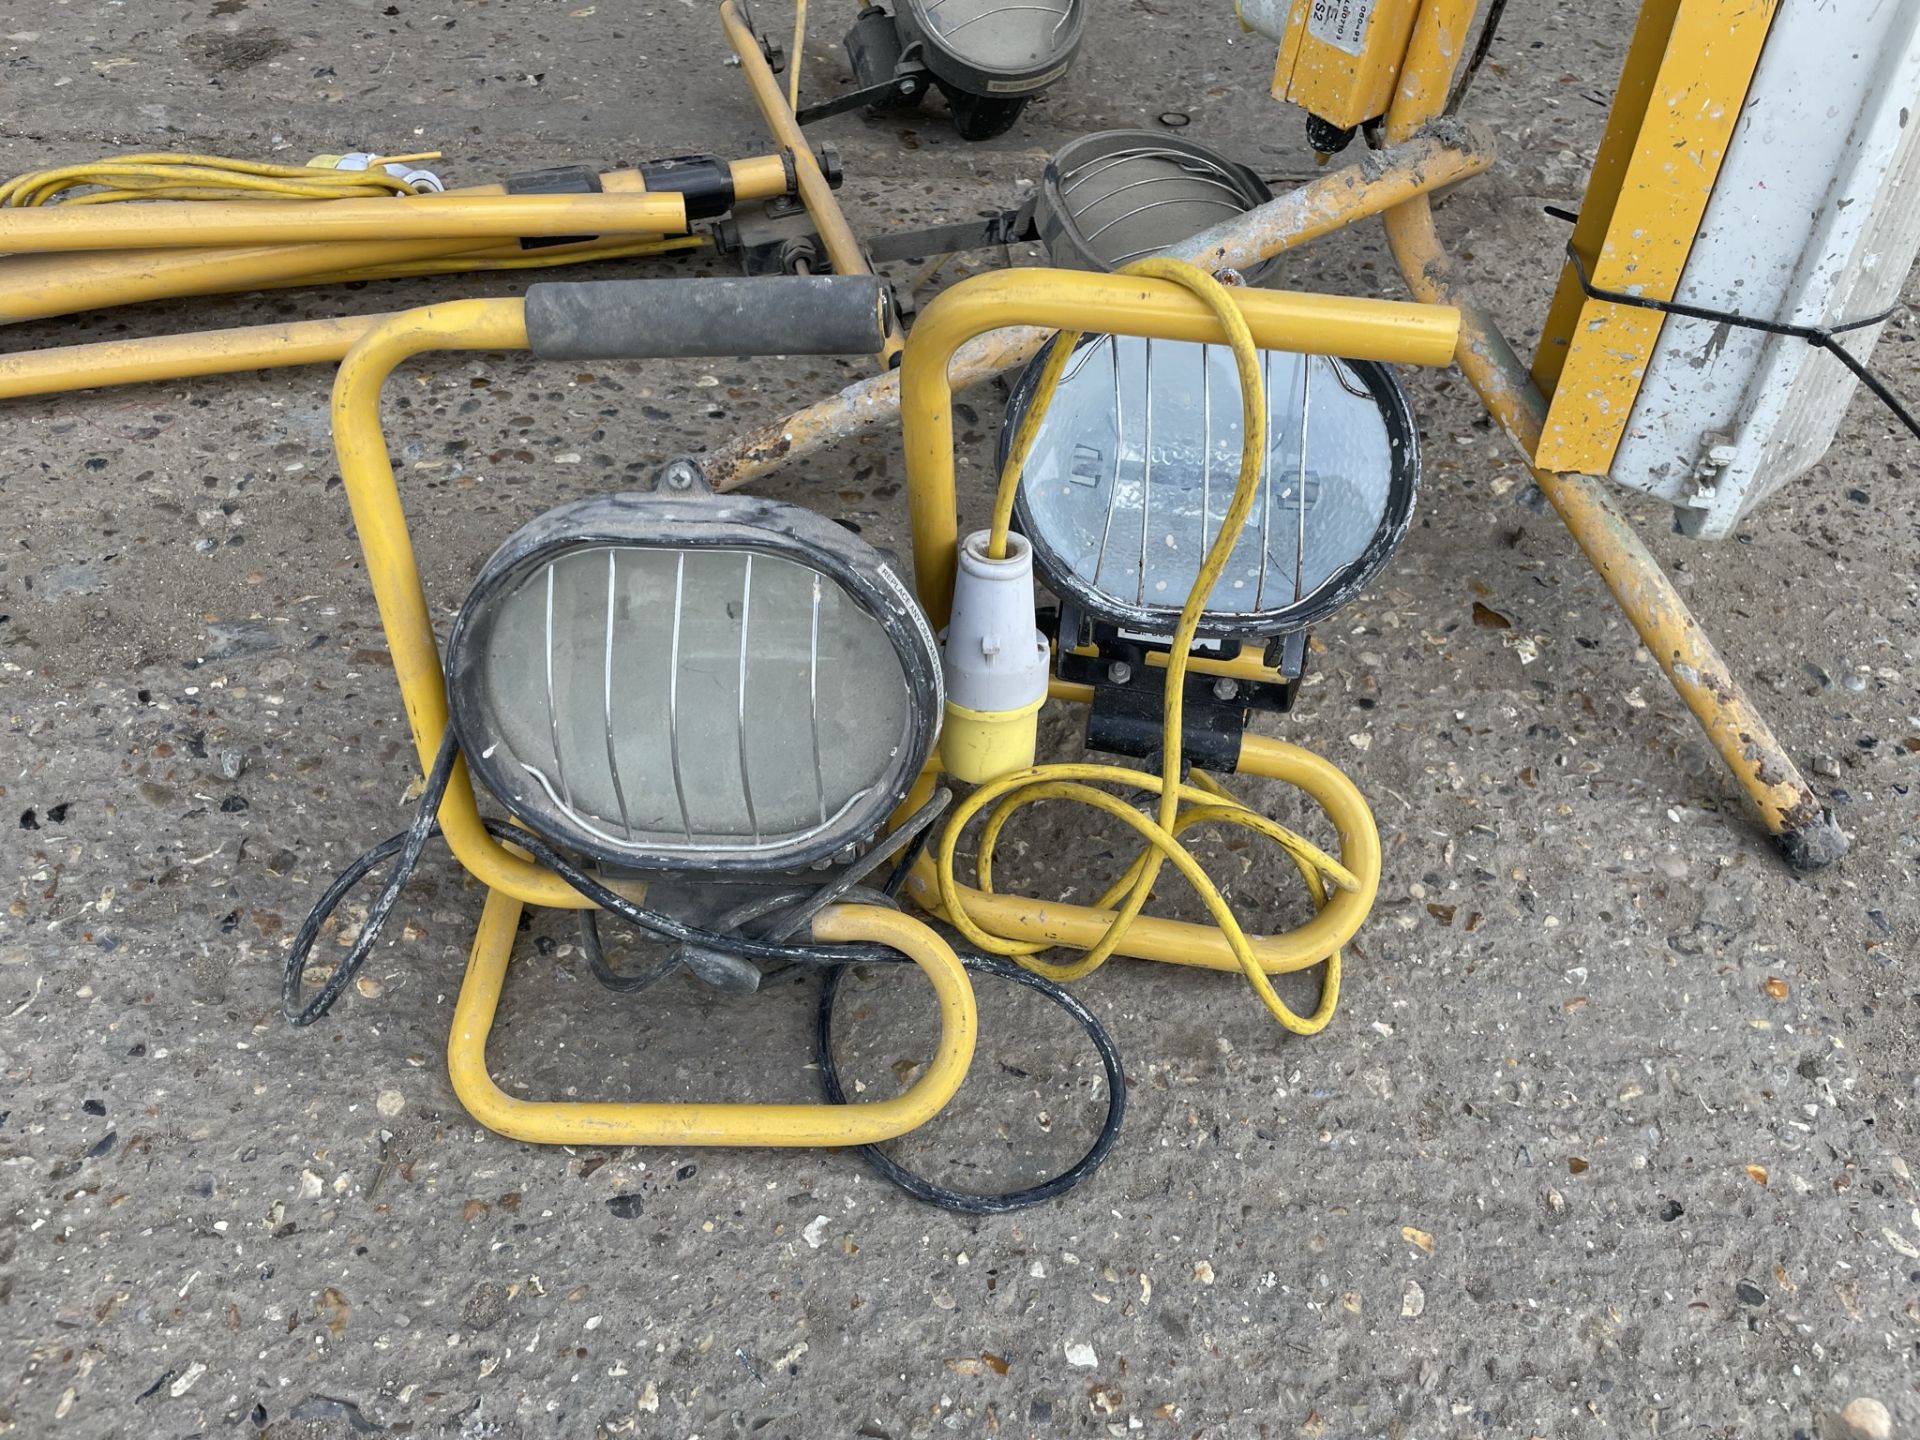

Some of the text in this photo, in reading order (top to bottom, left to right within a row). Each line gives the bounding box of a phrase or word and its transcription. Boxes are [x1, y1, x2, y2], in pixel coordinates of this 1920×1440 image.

[881, 568, 913, 607] REPLACE
[908, 604, 922, 623] ANY
[919, 621, 941, 665] CRACKED
